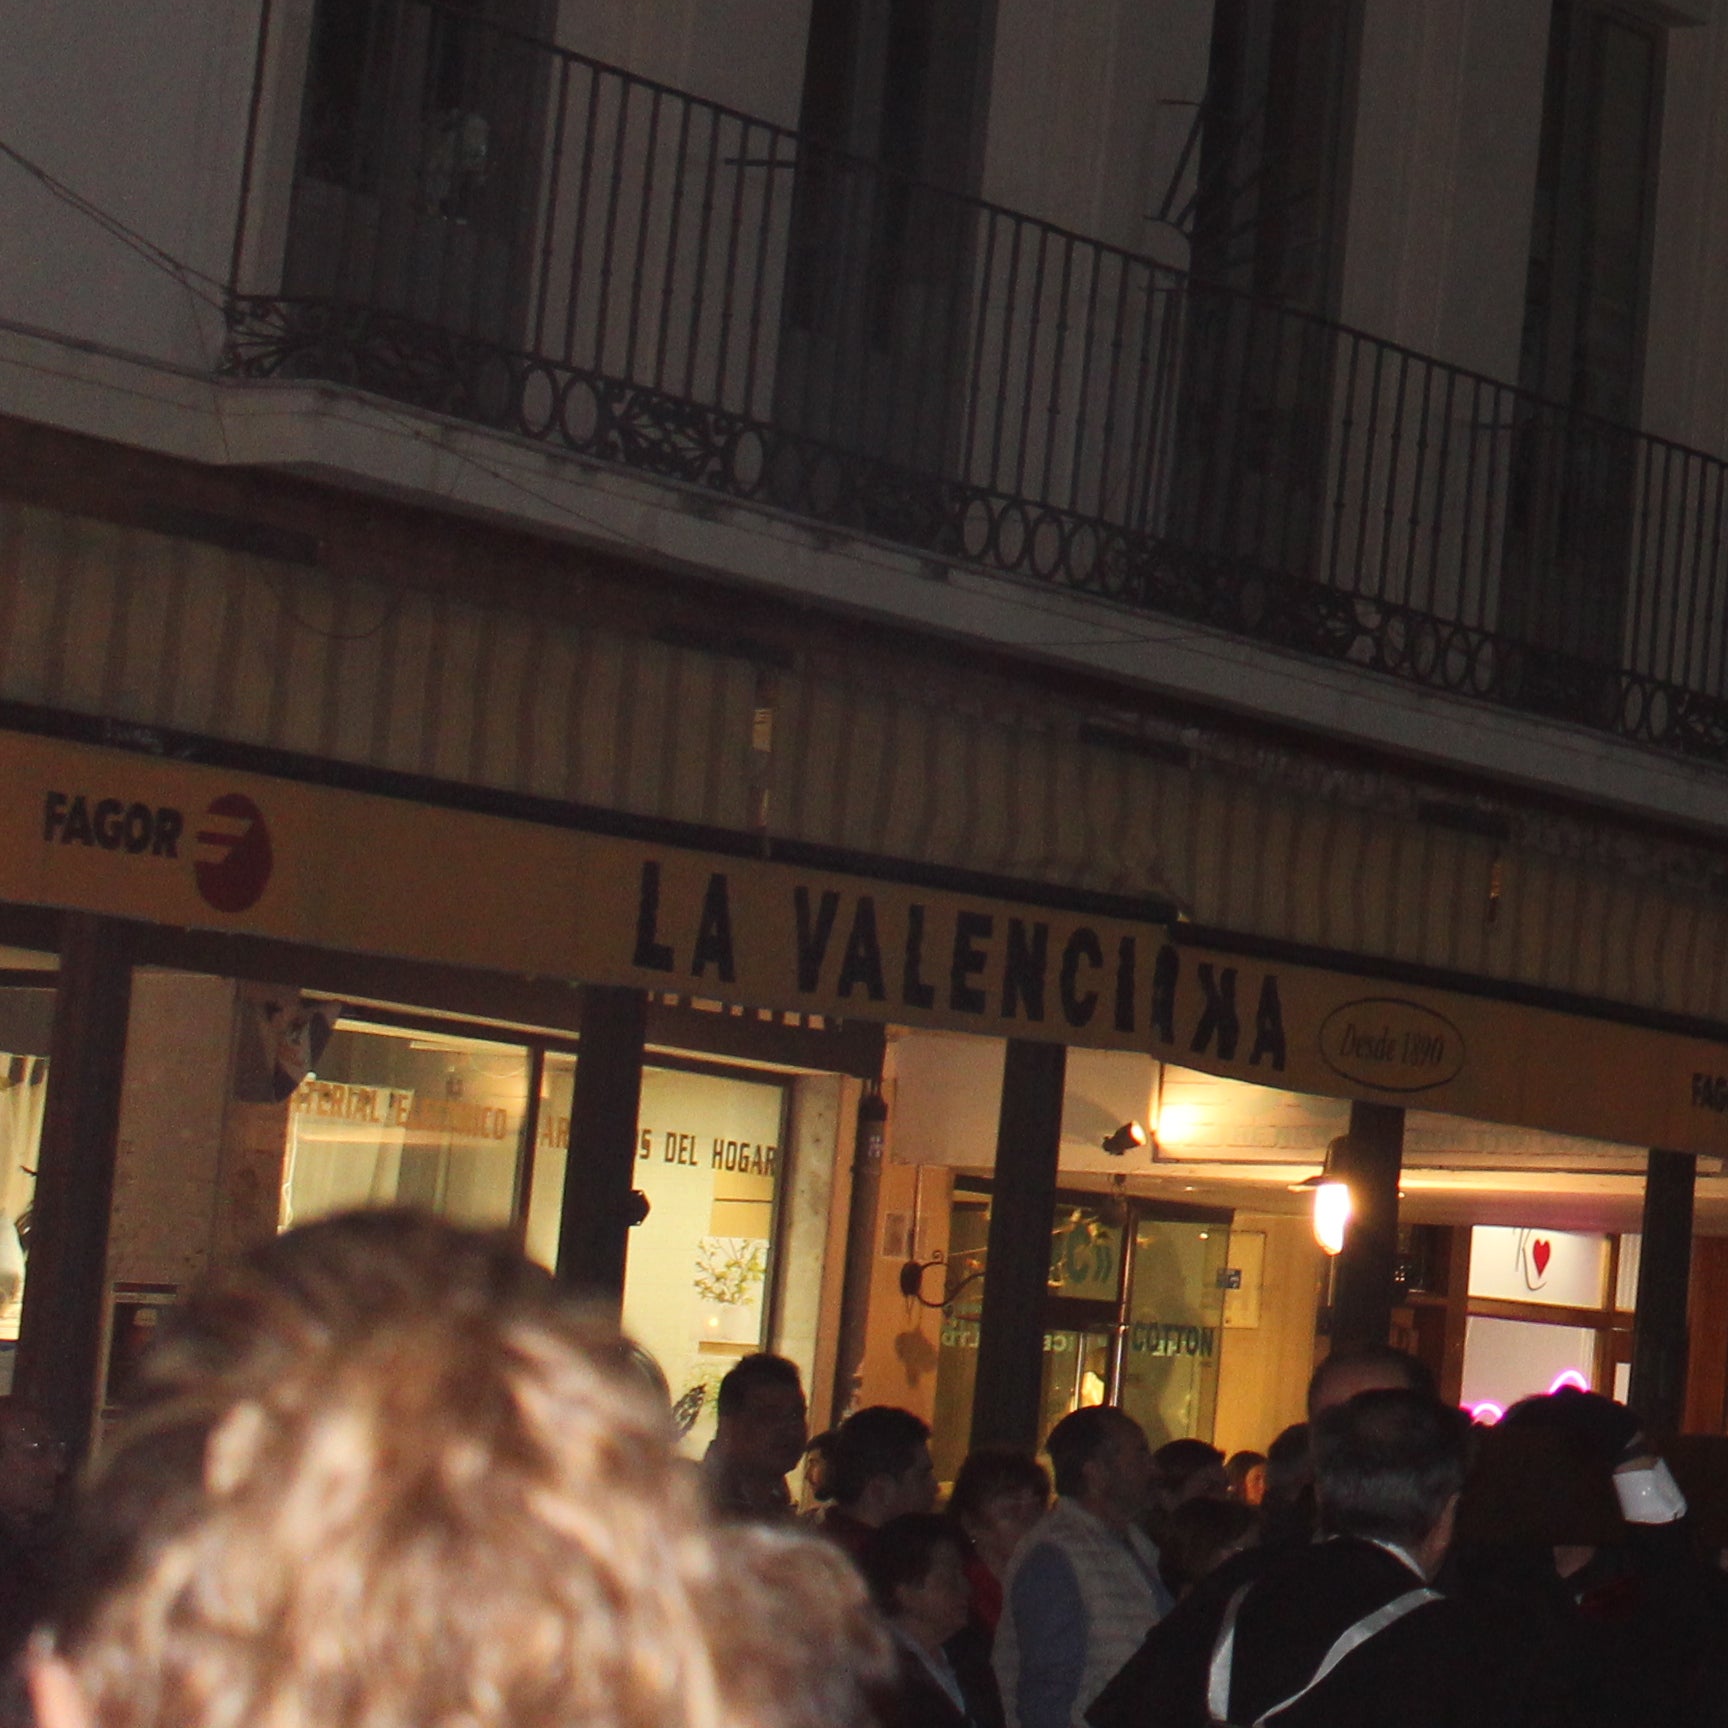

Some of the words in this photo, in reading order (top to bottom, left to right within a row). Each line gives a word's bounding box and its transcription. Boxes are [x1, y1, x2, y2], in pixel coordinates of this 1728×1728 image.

[43, 789, 184, 860] FAGOR
[632, 860, 736, 983] LA
[1339, 1023, 1396, 1062] Desde
[1400, 1030, 1446, 1069] 1890
[665, 1131, 698, 1166] DEL
[711, 1137, 777, 1177] HOGAR
[1131, 1320, 1214, 1357] COTTON
